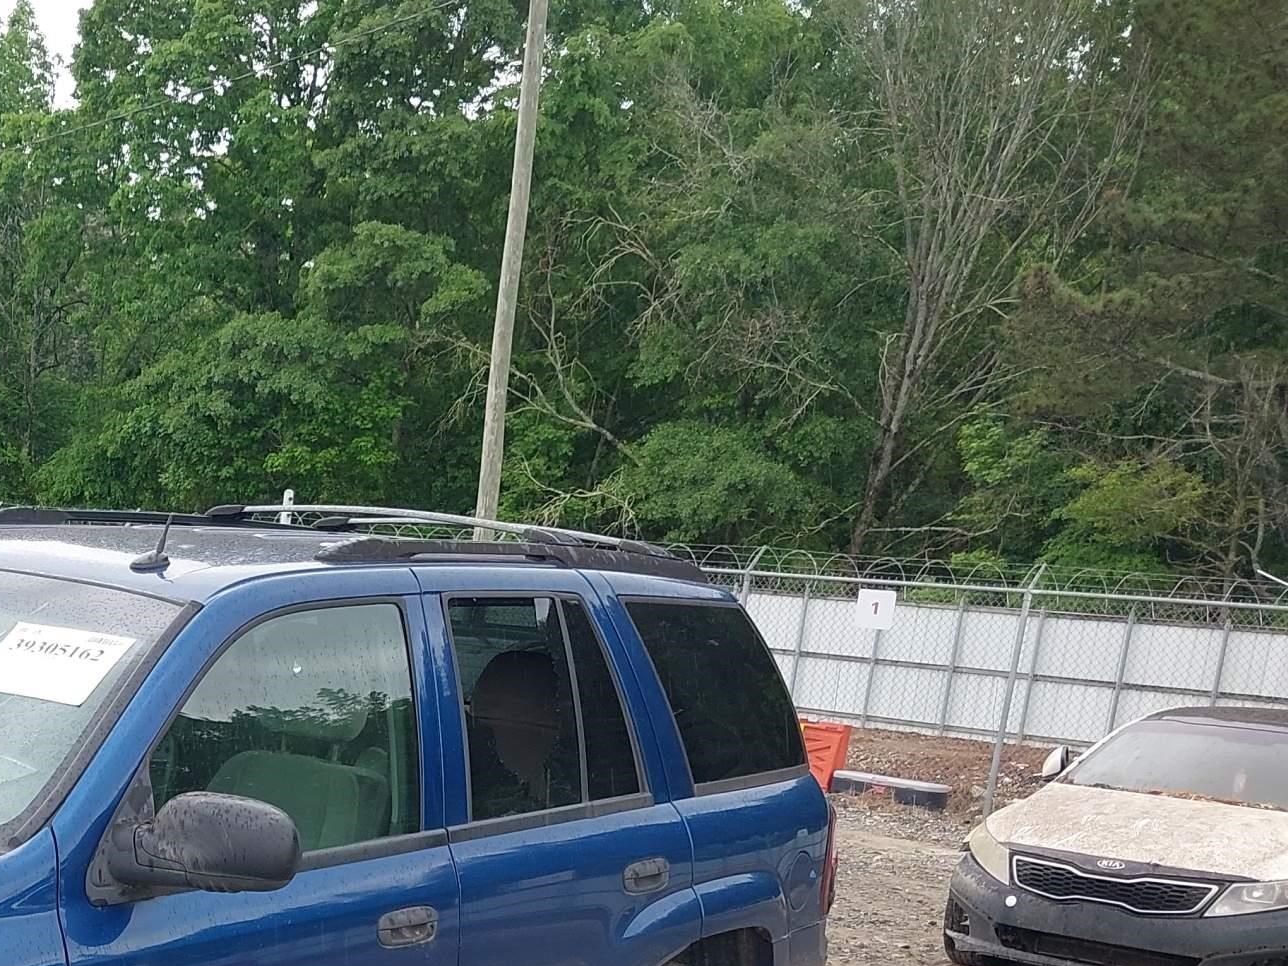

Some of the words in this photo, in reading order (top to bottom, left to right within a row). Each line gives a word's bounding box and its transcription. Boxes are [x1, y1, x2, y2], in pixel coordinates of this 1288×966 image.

[871, 601, 880, 615] 1
[9, 637, 106, 662] 39305162
[1099, 859, 1123, 868] KIA
